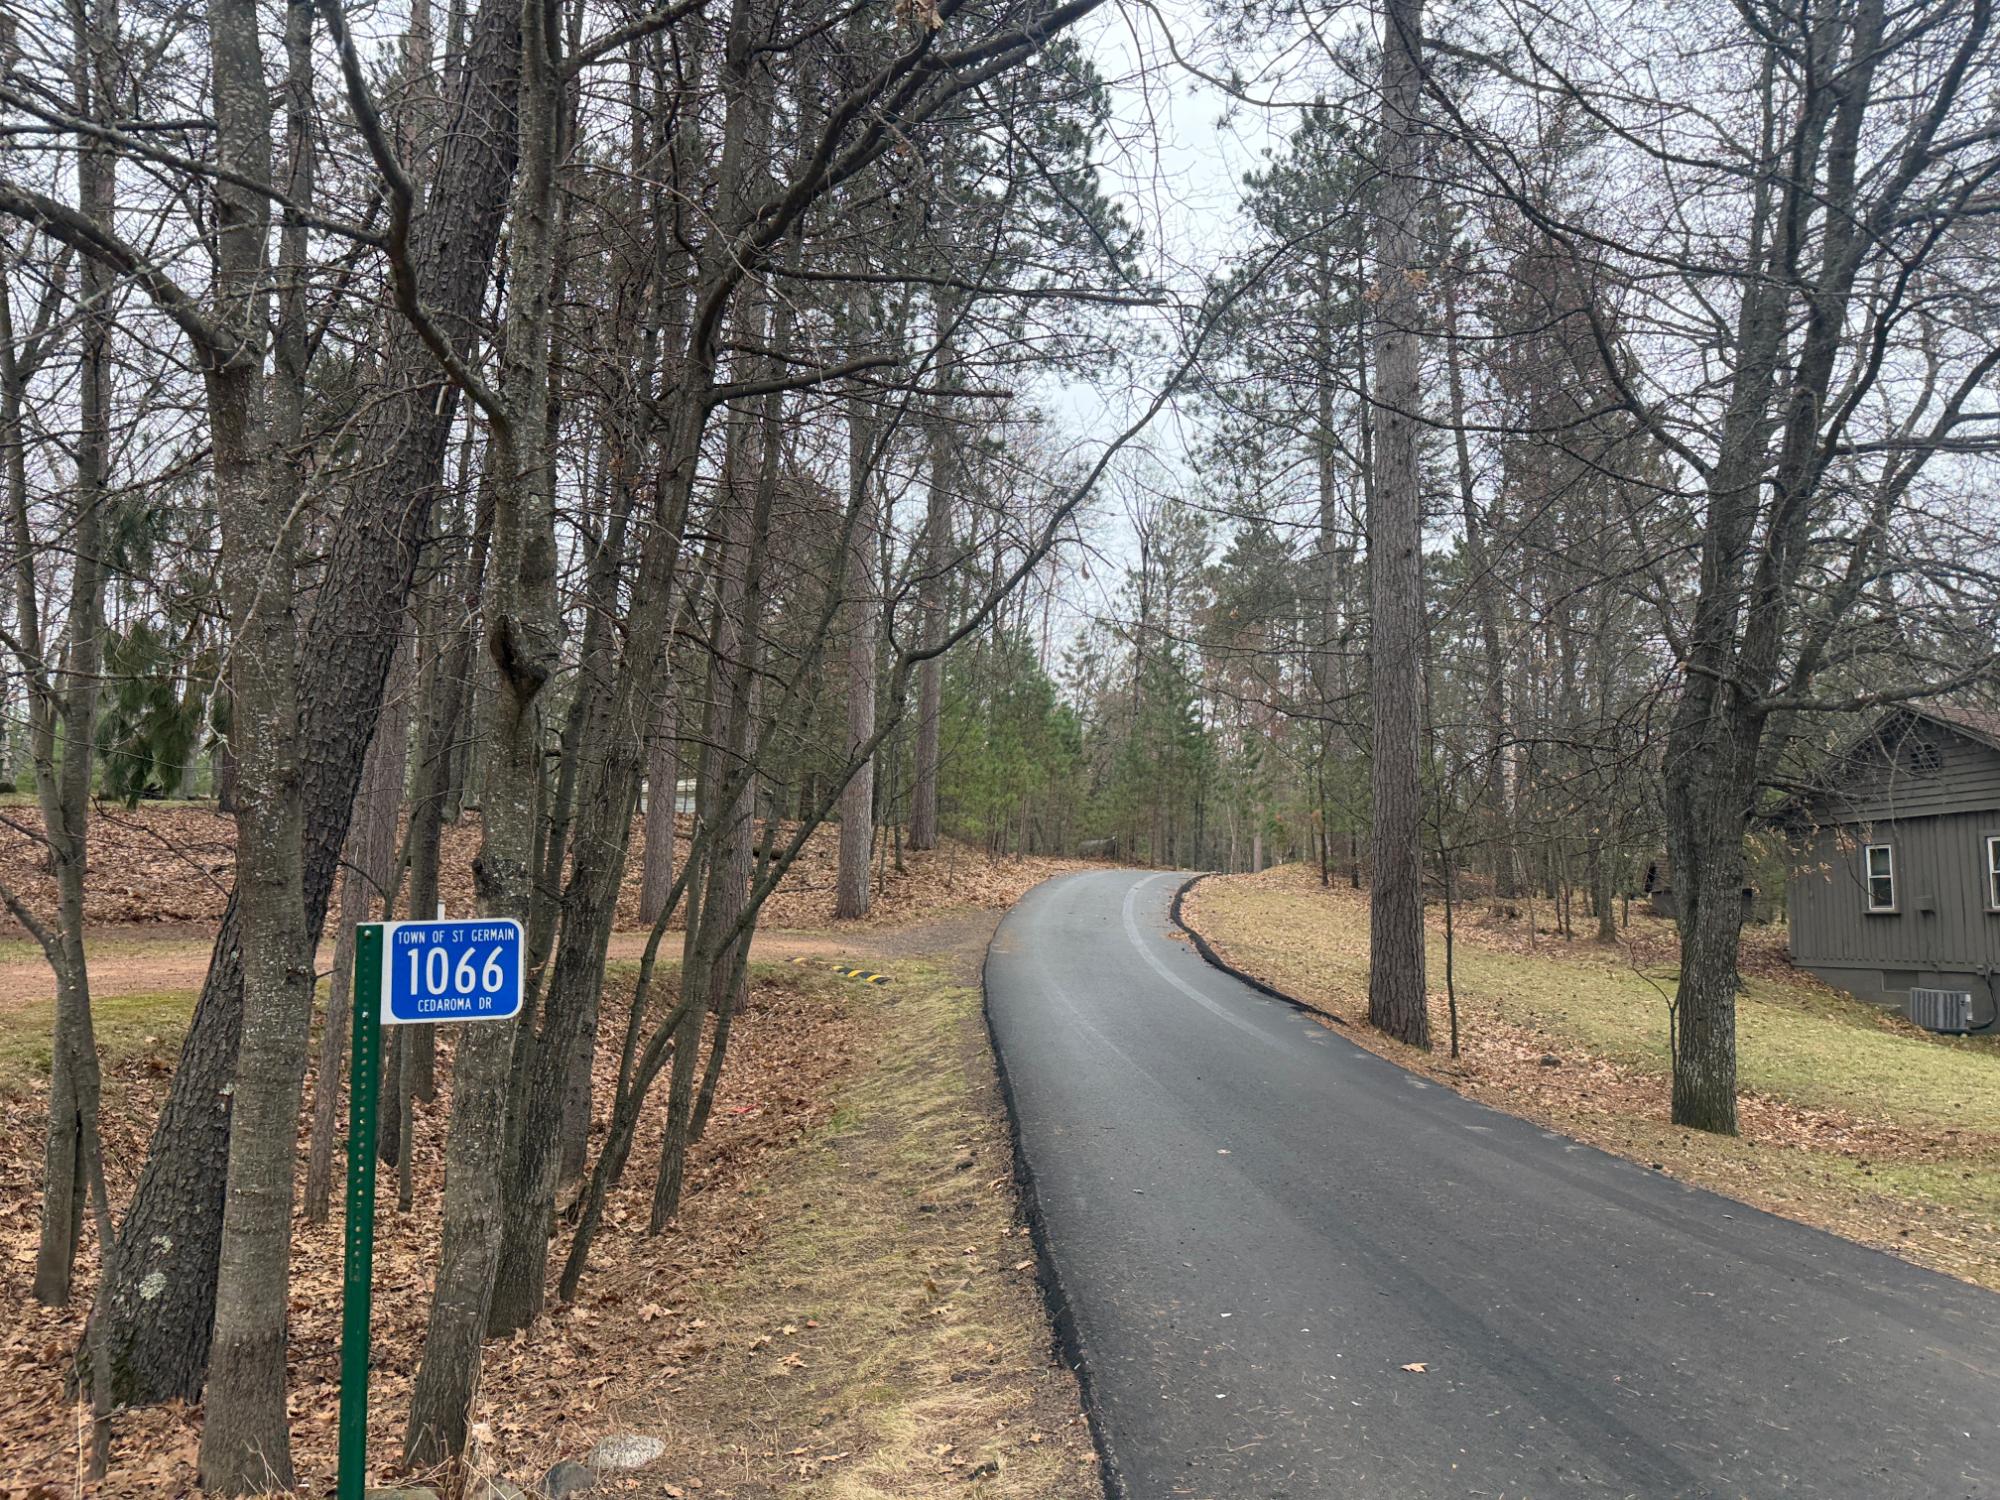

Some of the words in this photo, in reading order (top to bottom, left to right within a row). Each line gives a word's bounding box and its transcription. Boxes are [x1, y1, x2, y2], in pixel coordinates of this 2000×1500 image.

[398, 931, 426, 944] TOWN
[432, 930, 445, 943] OF
[452, 930, 464, 942] ST
[471, 928, 515, 942] GERMAIN
[407, 946, 504, 996] 1066
[417, 998, 472, 1012] CEDAROMA
[478, 997, 492, 1010] DR
